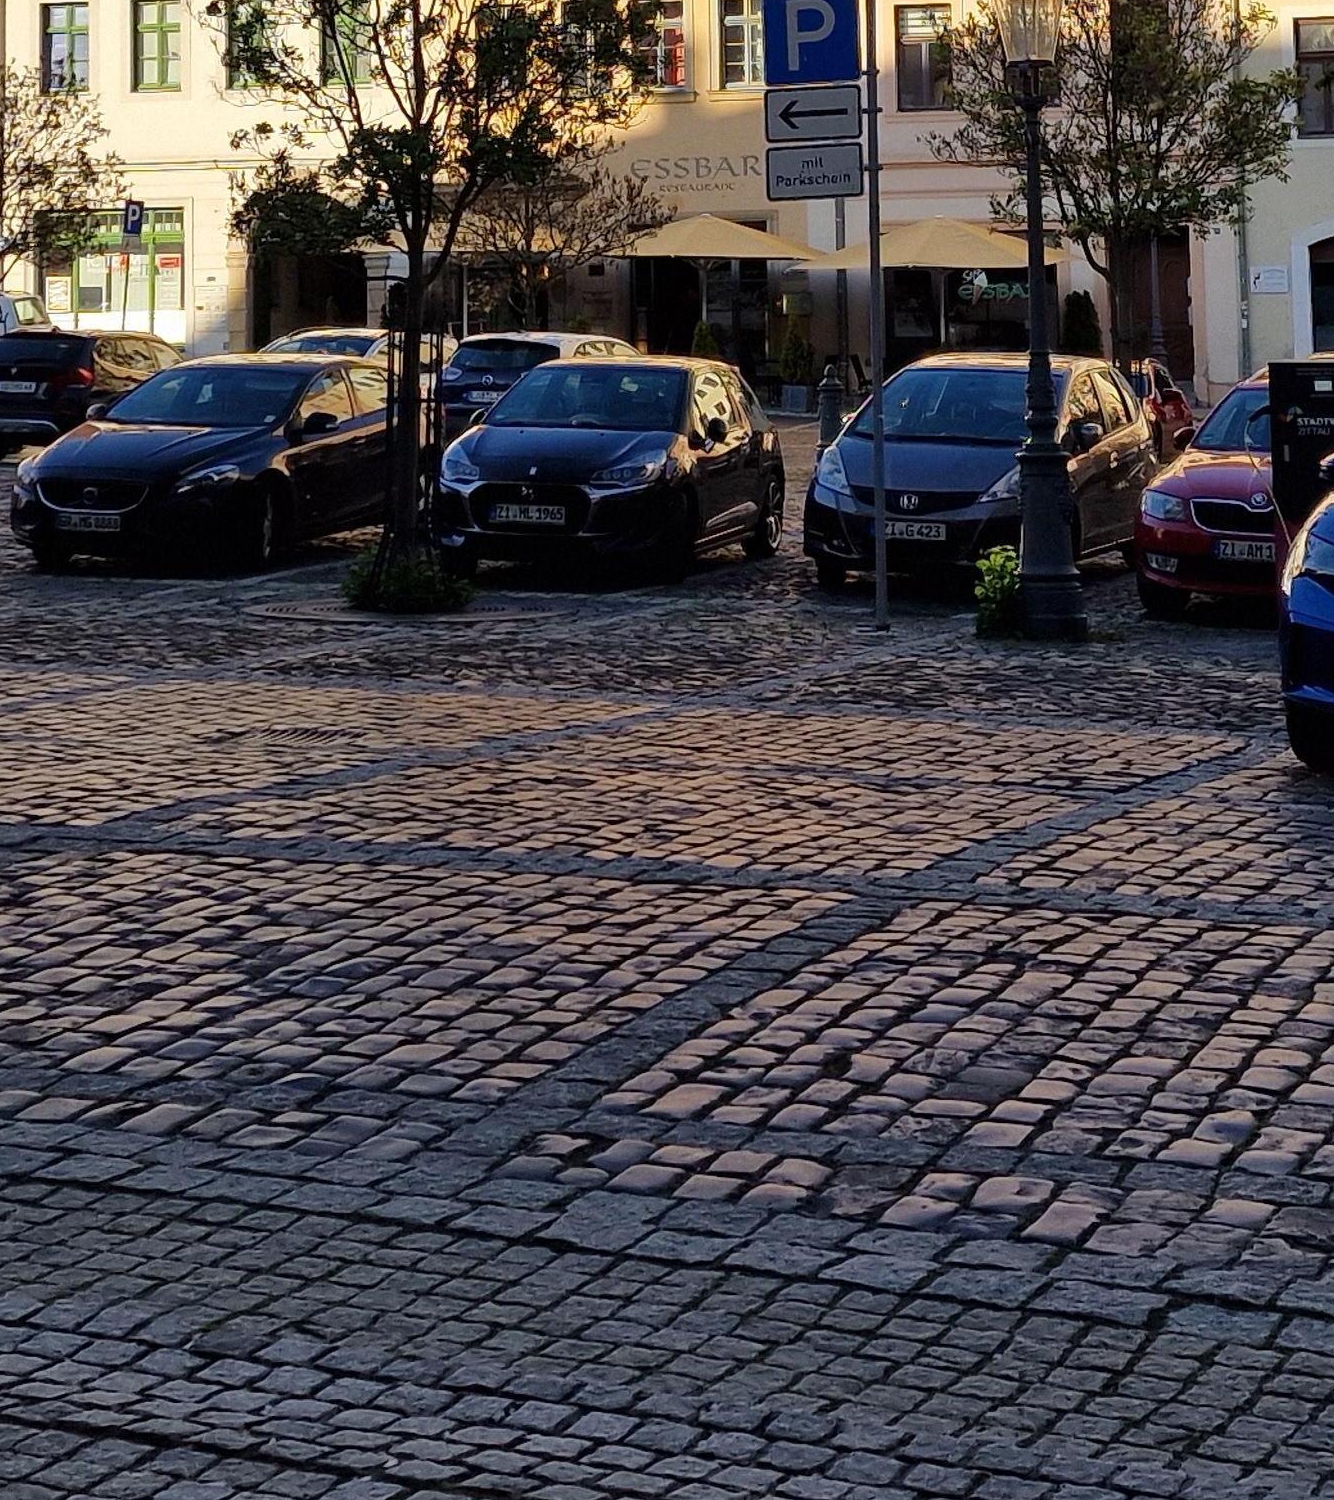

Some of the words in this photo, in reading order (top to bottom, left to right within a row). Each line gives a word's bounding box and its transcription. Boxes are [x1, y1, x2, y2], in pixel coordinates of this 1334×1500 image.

[630, 155, 764, 181] ESSBAR
[800, 156, 825, 171] mit
[775, 172, 852, 188] Parkschein
[127, 204, 140, 231] P
[1298, 427, 1330, 436] ZITTAU
